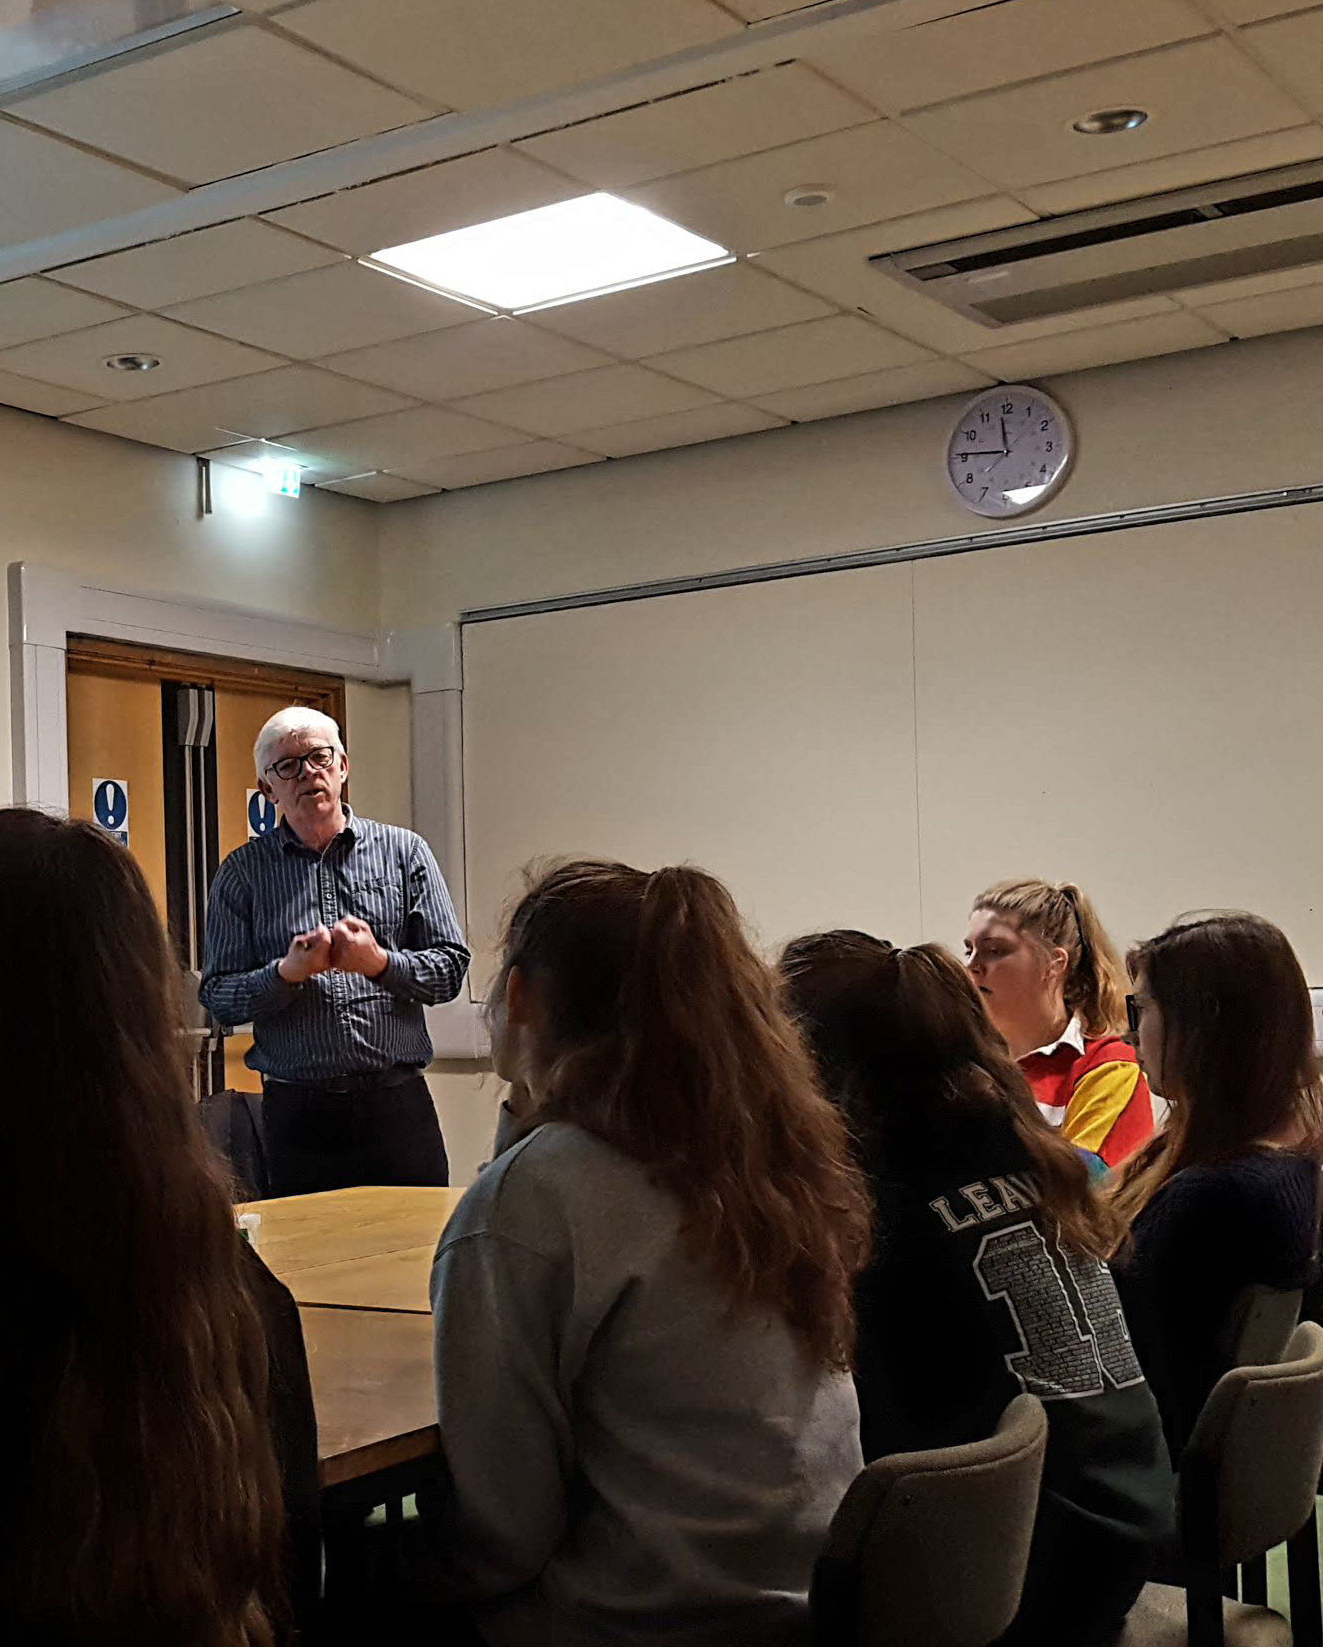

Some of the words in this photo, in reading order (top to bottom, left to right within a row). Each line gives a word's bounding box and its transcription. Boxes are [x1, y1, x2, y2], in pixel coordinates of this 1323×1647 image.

[1000, 403, 1013, 415] 12
[1026, 406, 1031, 418] 1
[980, 412, 990, 423] 11
[1040, 420, 1049, 431] 2
[965, 430, 977, 441] 10
[1045, 441, 1053, 452] 3
[960, 451, 968, 463] 9
[1039, 463, 1047, 474] 4
[966, 473, 974, 483] 8
[979, 487, 989, 503] 7
